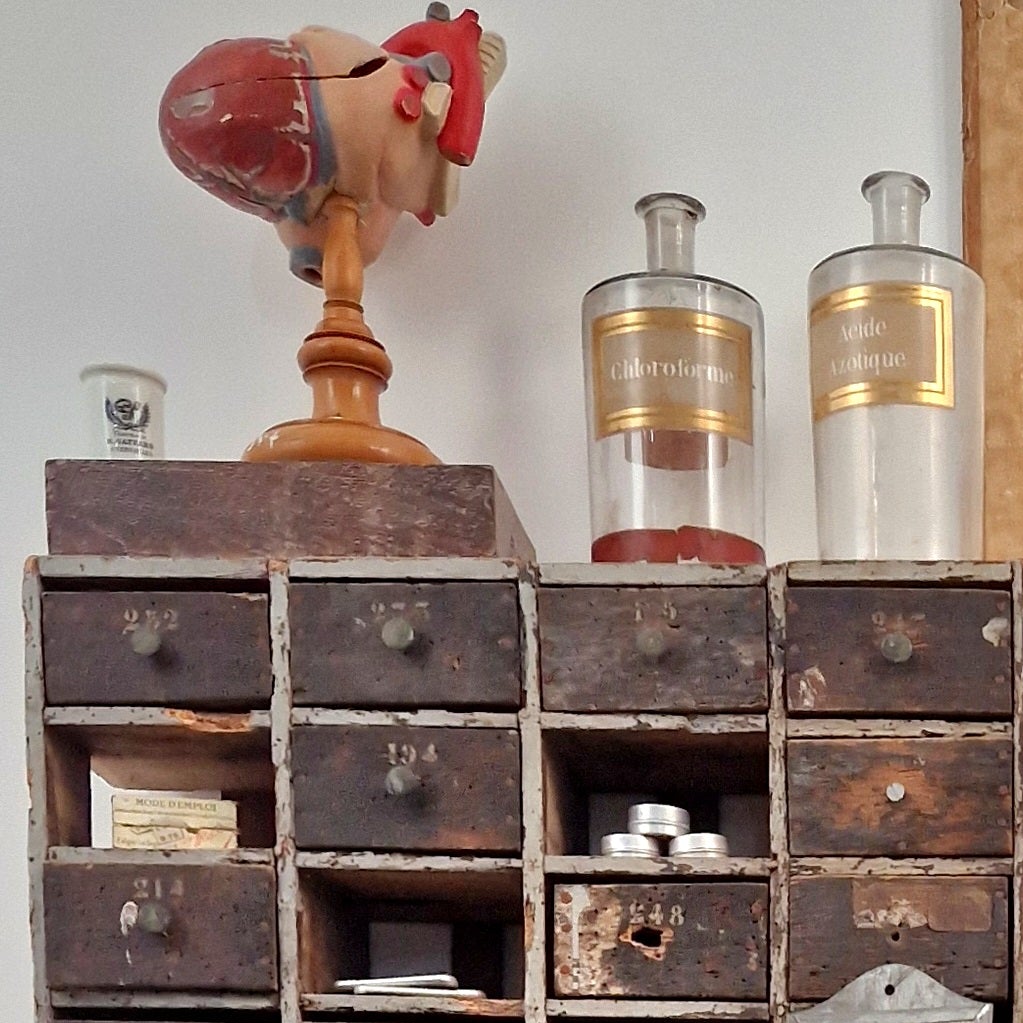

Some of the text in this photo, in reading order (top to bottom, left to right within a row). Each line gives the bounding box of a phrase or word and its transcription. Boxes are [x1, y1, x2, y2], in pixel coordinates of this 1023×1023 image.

[841, 317, 887, 341] Acide
[611, 357, 733, 384] Chloroforme
[831, 348, 906, 376] Azotique
